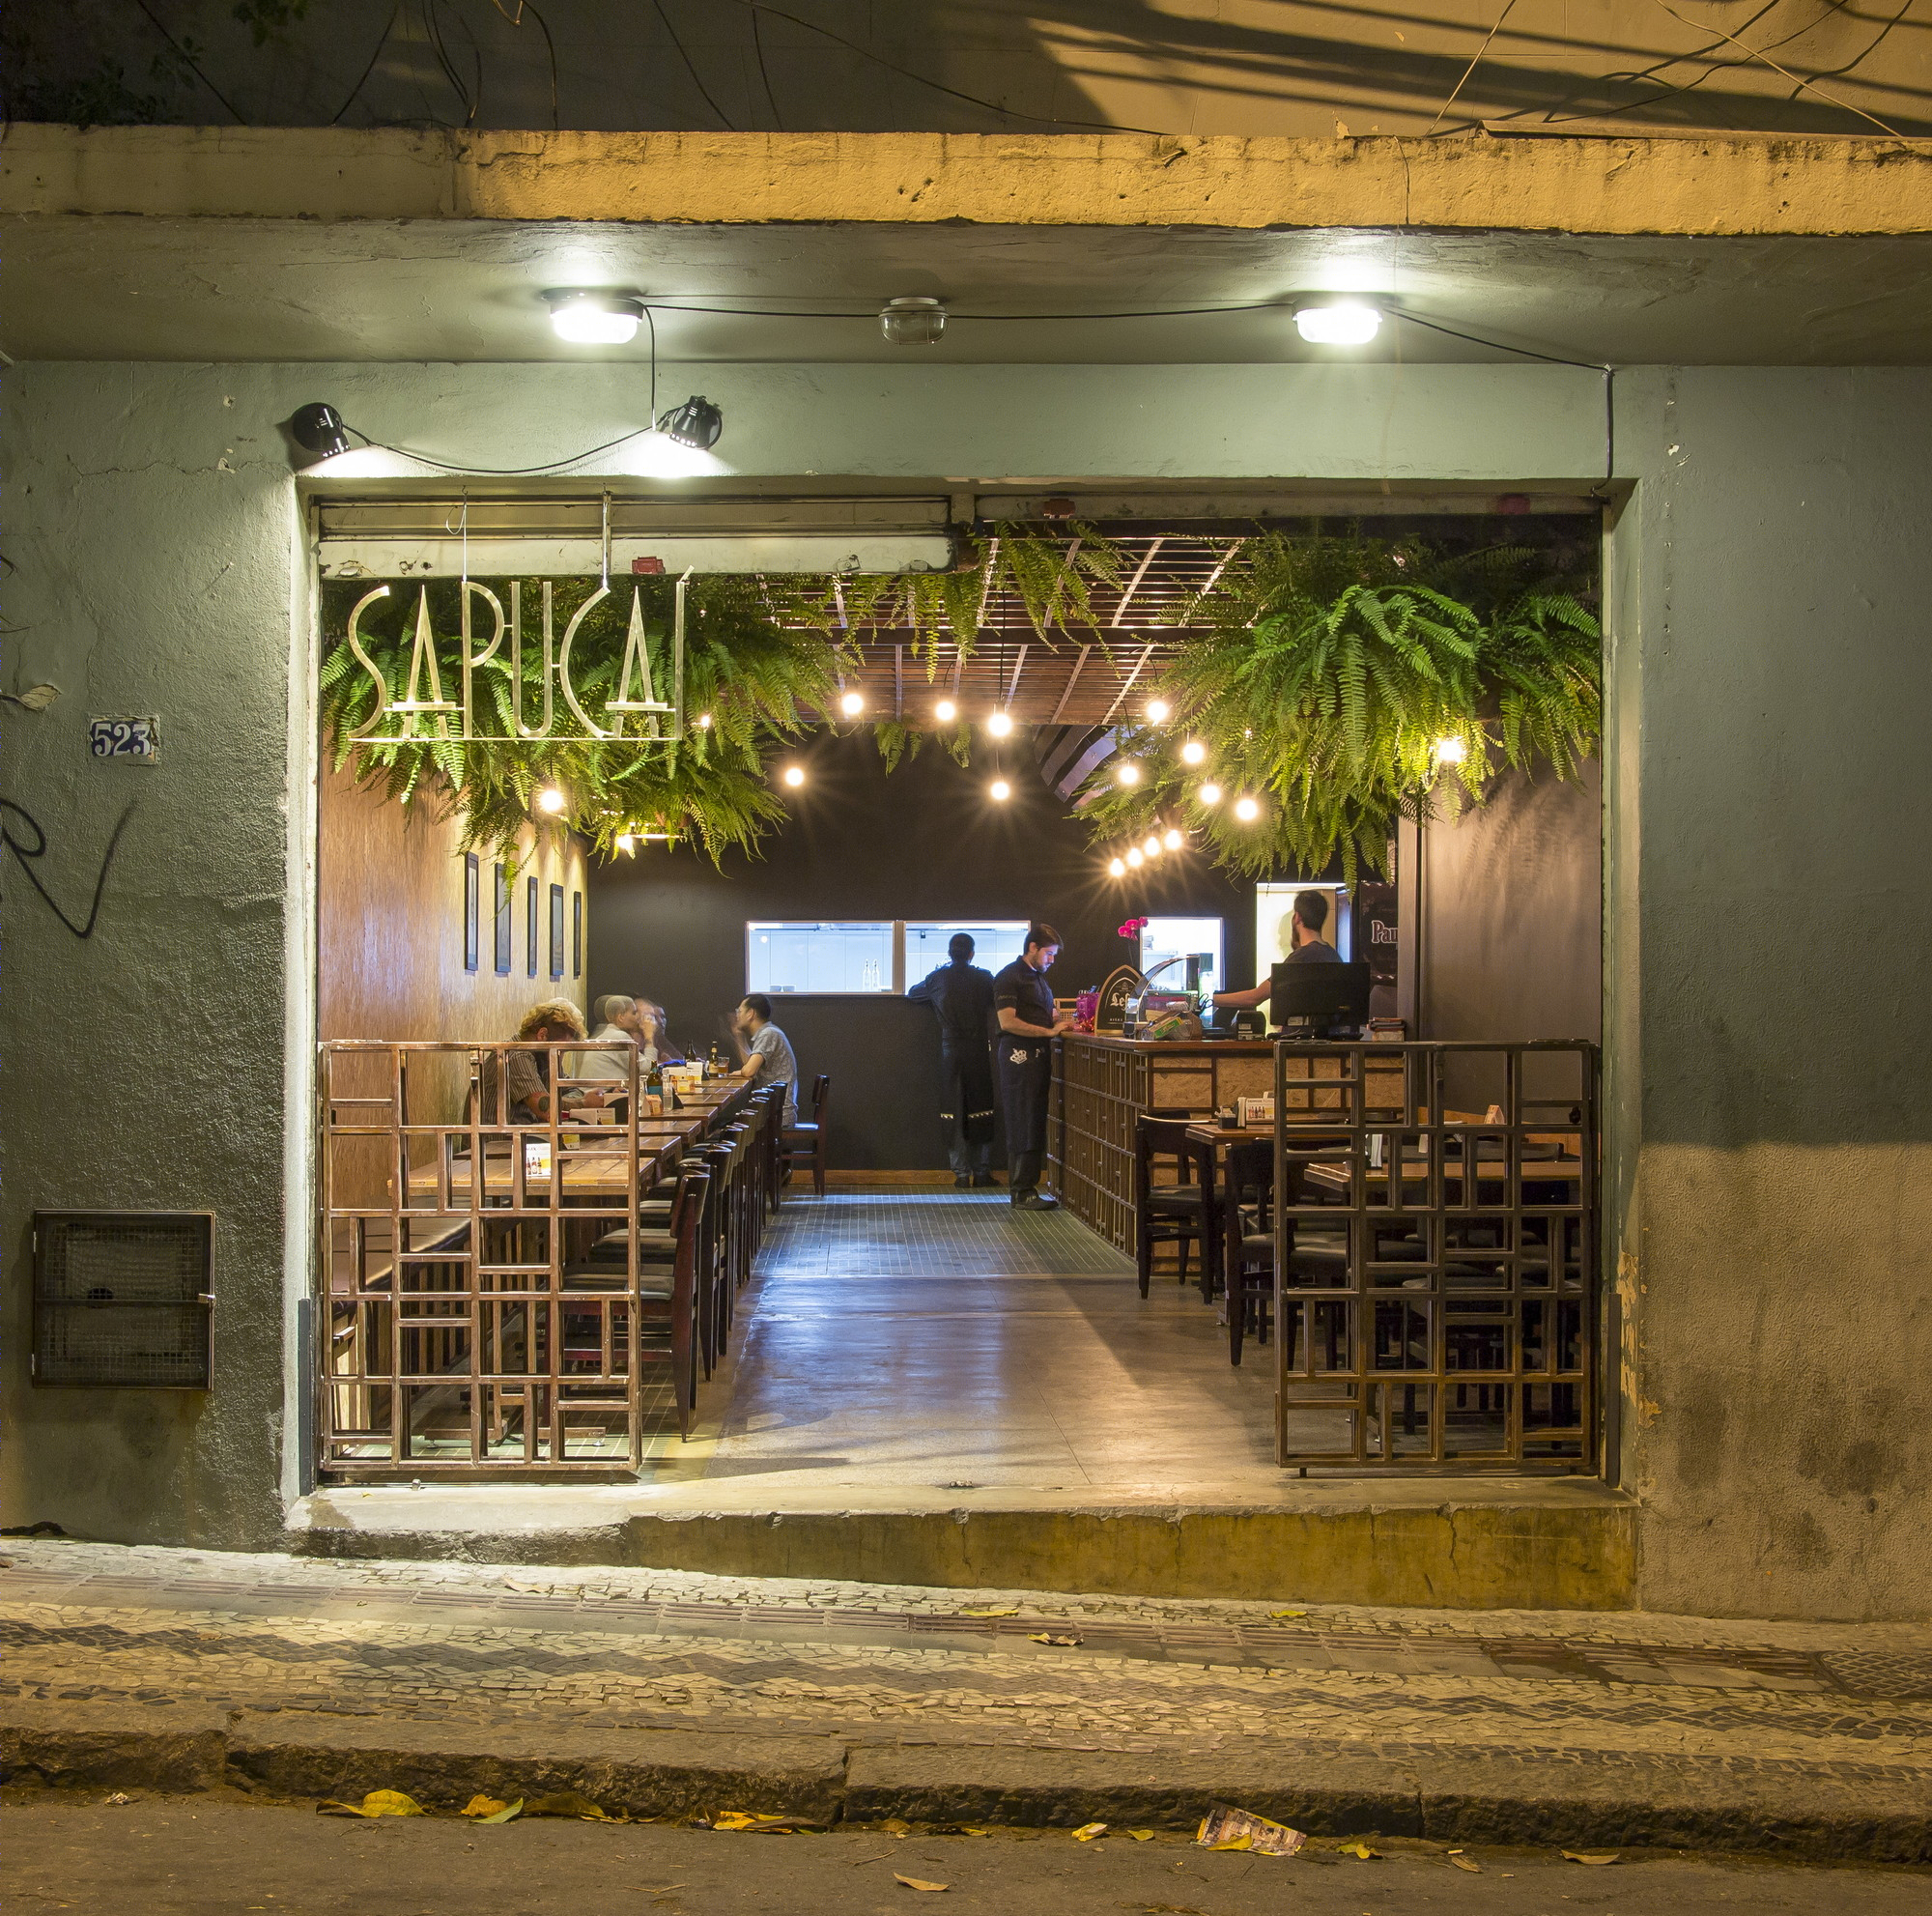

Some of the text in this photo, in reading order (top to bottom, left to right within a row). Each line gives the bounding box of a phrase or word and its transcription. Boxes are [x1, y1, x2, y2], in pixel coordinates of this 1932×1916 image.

[95, 723, 151, 757] 523
[1371, 919, 1399, 944] Pau
[1110, 992, 1130, 1012] Lef
